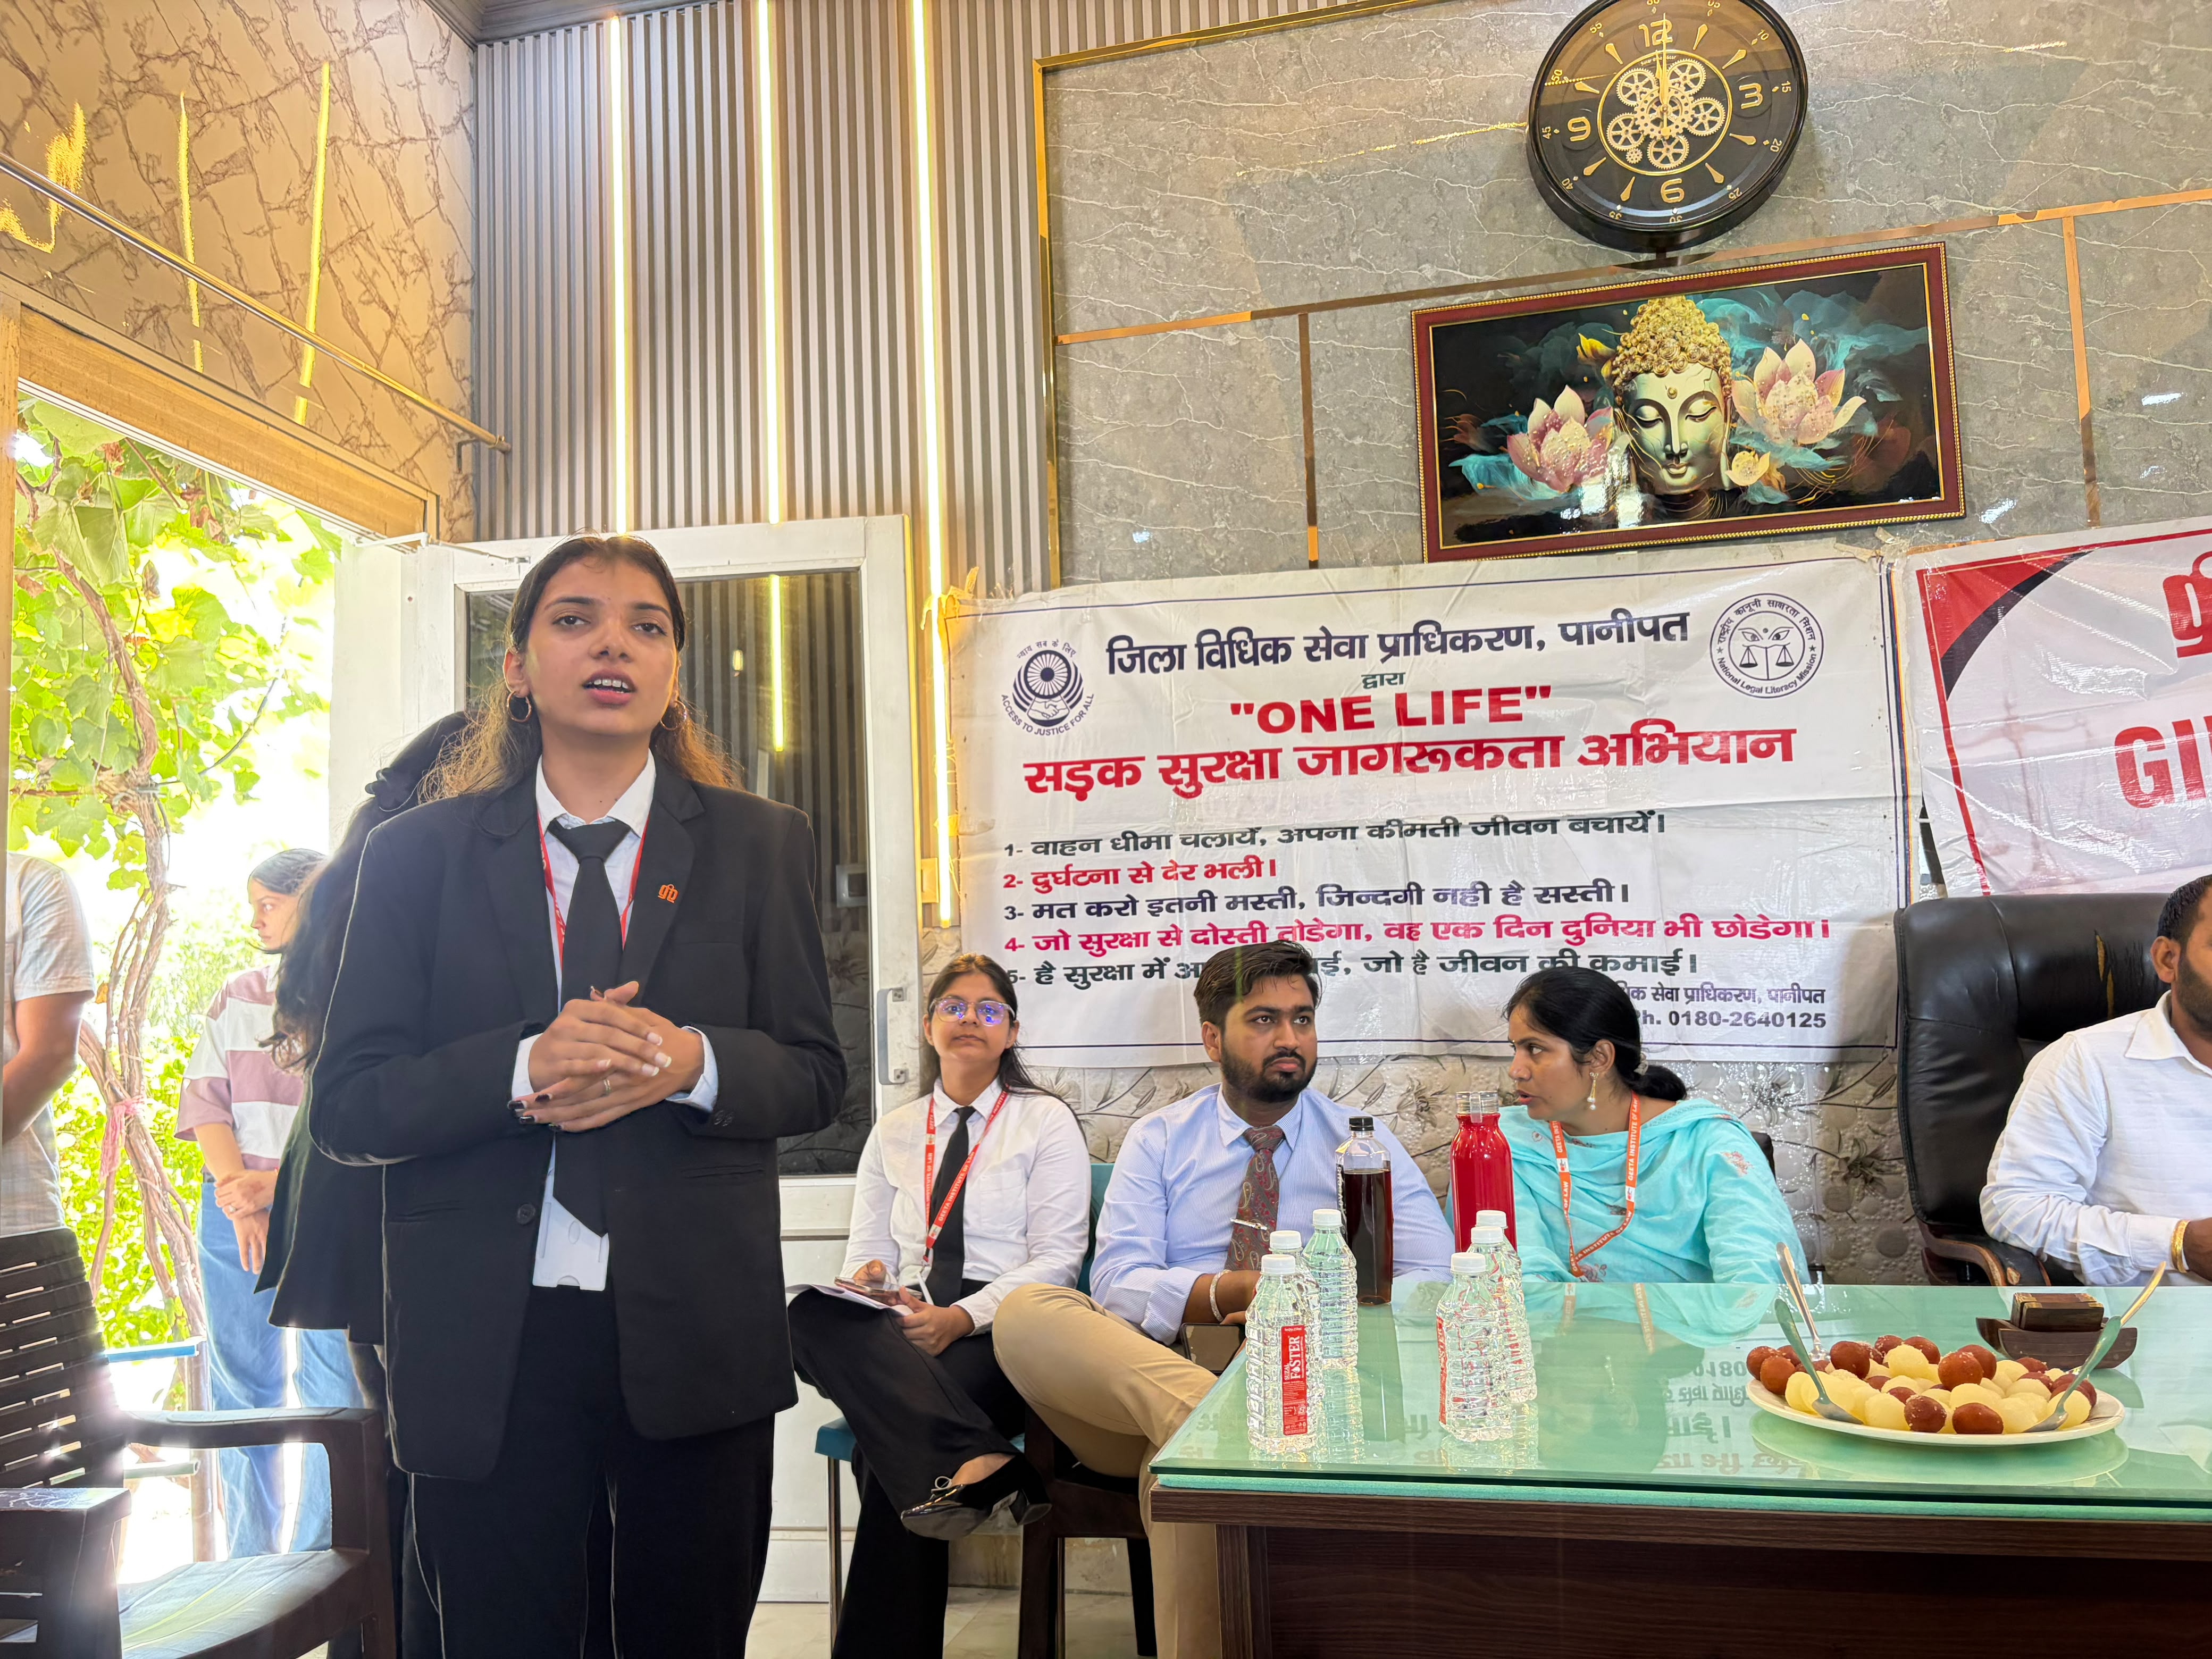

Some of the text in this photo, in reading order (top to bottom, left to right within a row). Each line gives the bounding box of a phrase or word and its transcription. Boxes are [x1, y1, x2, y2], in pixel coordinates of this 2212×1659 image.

[1590, 21, 1602, 34] 55
[1638, 19, 1673, 47] 12
[1758, 29, 1770, 41] 10
[1551, 69, 1563, 83] 50
[1781, 80, 1791, 93] 15
[1739, 82, 1763, 109] 3
[1542, 126, 1552, 140] 45
[1567, 116, 1591, 142] 9
[1770, 138, 1783, 153] 20
[1561, 178, 1575, 191] 40
[1661, 178, 1685, 203] 6
[1728, 187, 1742, 201] 25
[1609, 211, 1622, 220] 35
[1734, 598, 1762, 616] कानूनी
[1799, 616, 1815, 640] मिशन
[1017, 645, 1033, 659] न्याय
[1062, 642, 1076, 658] लिए
[1106, 608, 1690, 675] जिला विधिक सेवा प्राधिकरण, पानीपत
[1361, 672, 1405, 690] द्वारा
[1717, 653, 1816, 694] National Legal Literacy Mission
[1001, 693, 1094, 736] ACCESS TO JUSTICE FOR ALL
[1230, 685, 1552, 735] "ONE LIFE"
[1023, 718, 1797, 802] सड़क सुरक्षा जागरूकता अभियान
[2114, 715, 2212, 809] GI
[1030, 838, 1102, 857] वाहन
[1110, 830, 1171, 852] धीमा
[1277, 826, 1359, 844] अपना
[1366, 816, 1462, 839] कीमती
[1469, 815, 1560, 837] जीवन
[1031, 864, 1119, 894] दुर्घटना
[1128, 860, 1155, 884] से
[1161, 859, 1198, 880] देर
[1033, 903, 1077, 919] मत
[1084, 893, 1139, 918] करो
[1146, 889, 1218, 917] इतनी
[1225, 886, 1305, 911] मस्ती,
[1316, 882, 1425, 907] जिन्दगी
[1432, 880, 1492, 907] नही
[1500, 879, 1525, 906] है
[1033, 928, 1071, 950] जो
[1078, 930, 1151, 958] सुरक्षा
[1158, 923, 1184, 947] से
[1190, 919, 1269, 945] दोस्ती
[1383, 921, 1423, 942] वह
[1430, 921, 1485, 941] एक
[1493, 914, 1554, 939] दिन
[1561, 912, 1656, 946] दुनिया
[1664, 912, 1704, 939] भी
[1033, 960, 1057, 985] है
[1063, 961, 1135, 990] सुरक्षा
[1142, 957, 1170, 979] में
[1360, 950, 1404, 974] जो
[1411, 949, 1429, 975] है
[1436, 949, 1529, 974] जीवन
[1538, 948, 1581, 969] की
[1651, 982, 1680, 1002] सेवा
[1683, 982, 1762, 1005] प्राधिकरण,
[1767, 983, 1826, 1004] पानीपत
[1669, 1010, 1826, 1028] 0180-2640125
[947, 1172, 965, 1204] INSTITUTE
[1582, 1233, 1615, 1254] INSTITUTE
